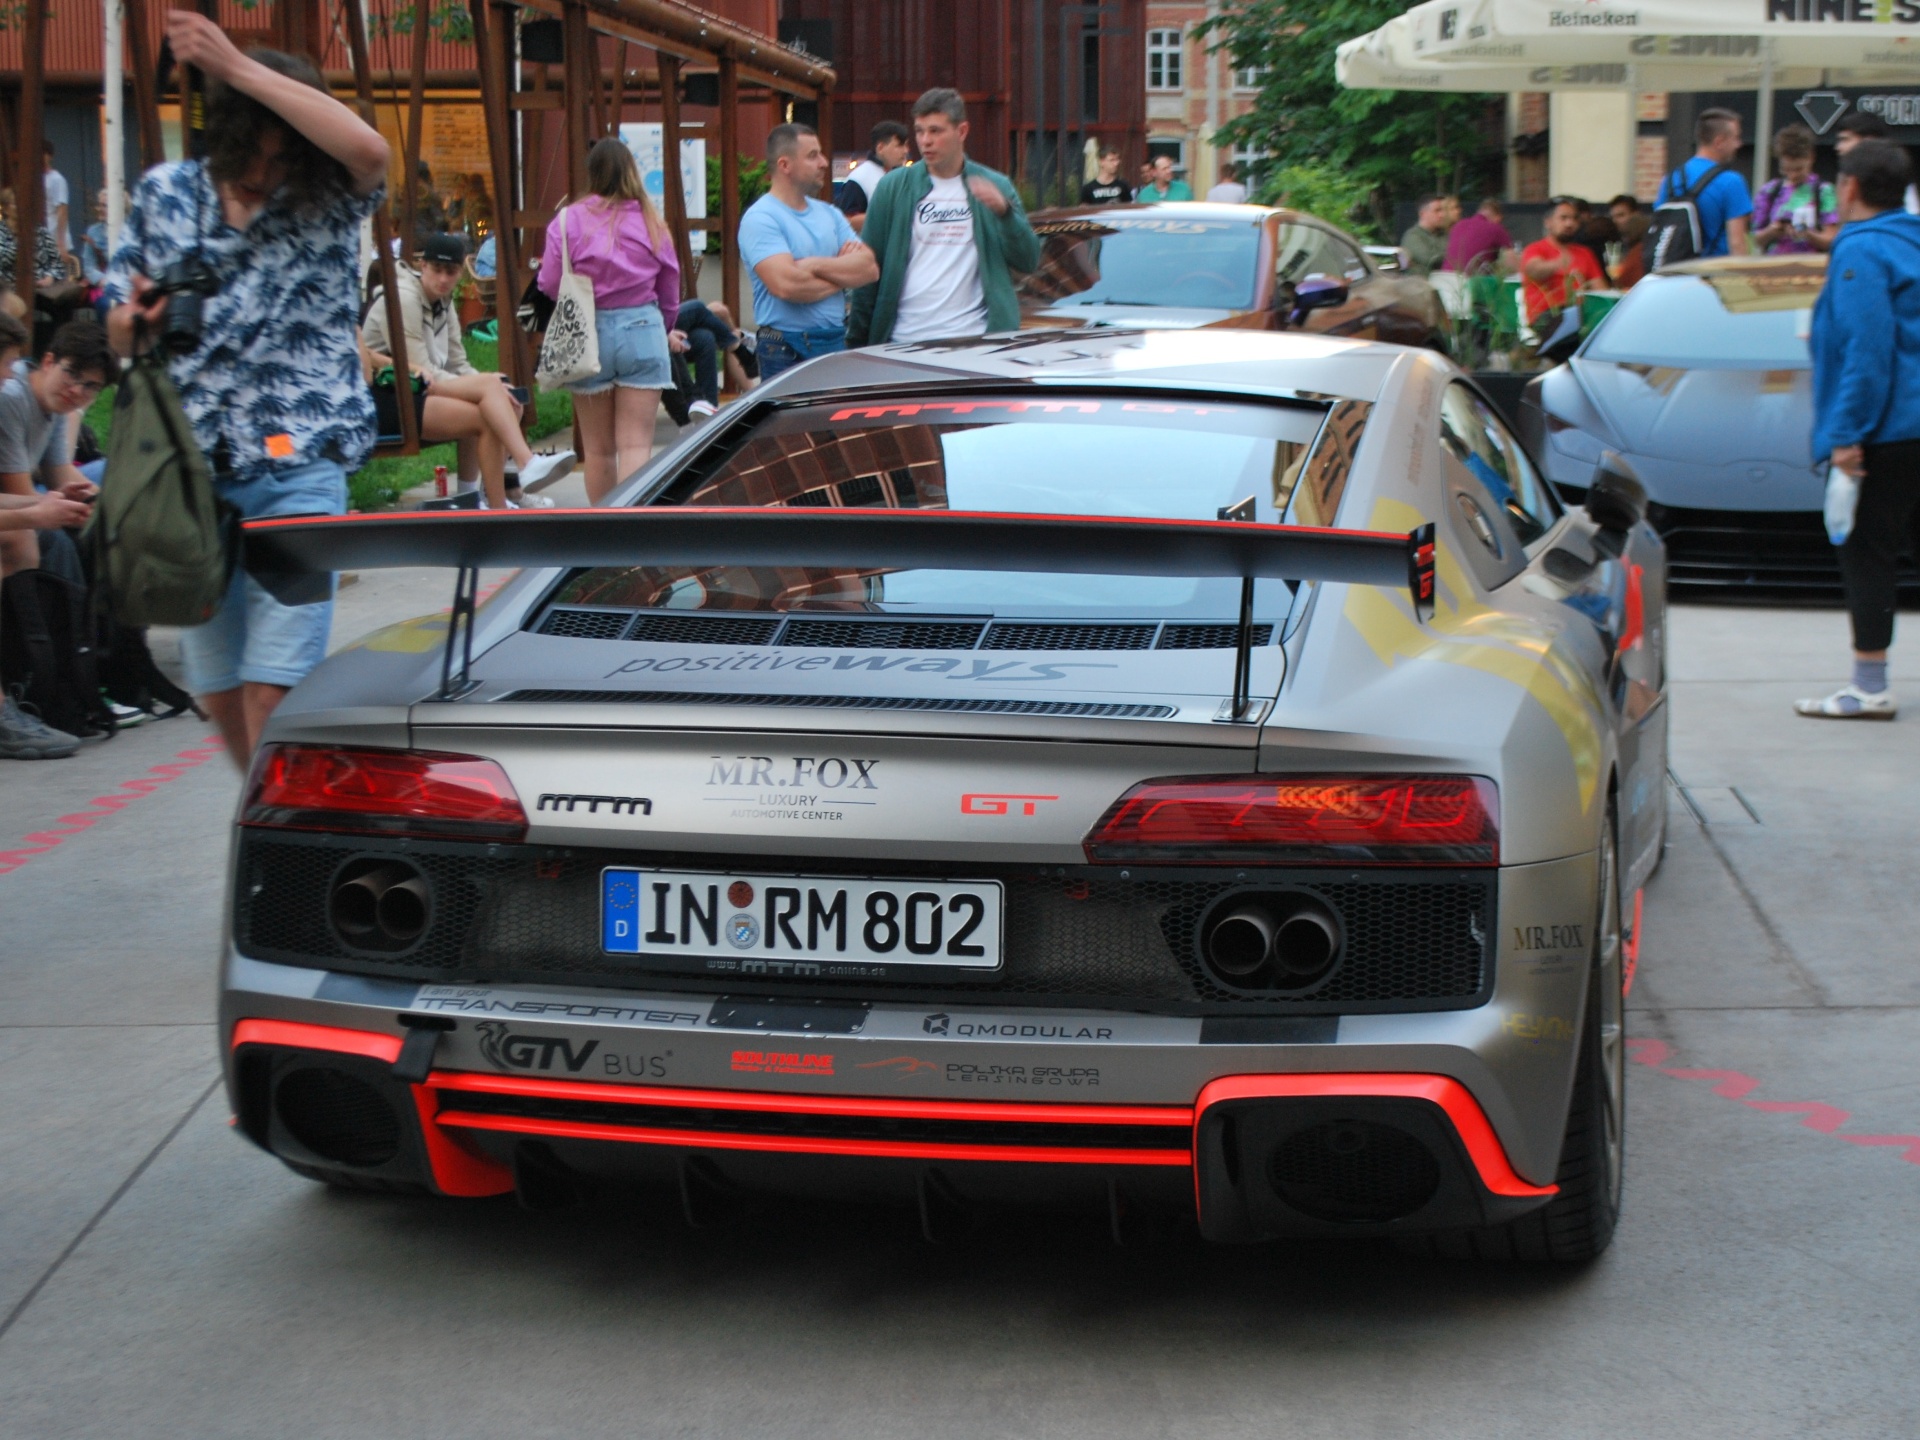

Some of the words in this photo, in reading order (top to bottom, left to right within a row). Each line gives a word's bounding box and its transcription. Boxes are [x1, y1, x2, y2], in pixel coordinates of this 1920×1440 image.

[1548, 11, 1638, 27] Heineken
[604, 650, 1119, 682] positiveways
[706, 755, 880, 790] MR.FOX
[759, 795, 818, 807] LUXURY
[961, 794, 1060, 816] GT
[730, 809, 800, 819] AUTOMOTIVE
[801, 812, 843, 821] CENTER
[615, 920, 629, 938] D
[645, 882, 719, 946] IN
[764, 886, 847, 952] RM
[863, 891, 985, 957] 802
[1513, 925, 1585, 950] MR.FOX
[418, 997, 701, 1026] TRANSPORTER
[957, 1024, 1113, 1039] QMODULAR
[503, 1035, 600, 1072] GTV
[946, 1063, 1025, 1075] POLSKA
[1032, 1067, 1099, 1077] GRUPA
[946, 1073, 1099, 1086] LEASINGOWA
